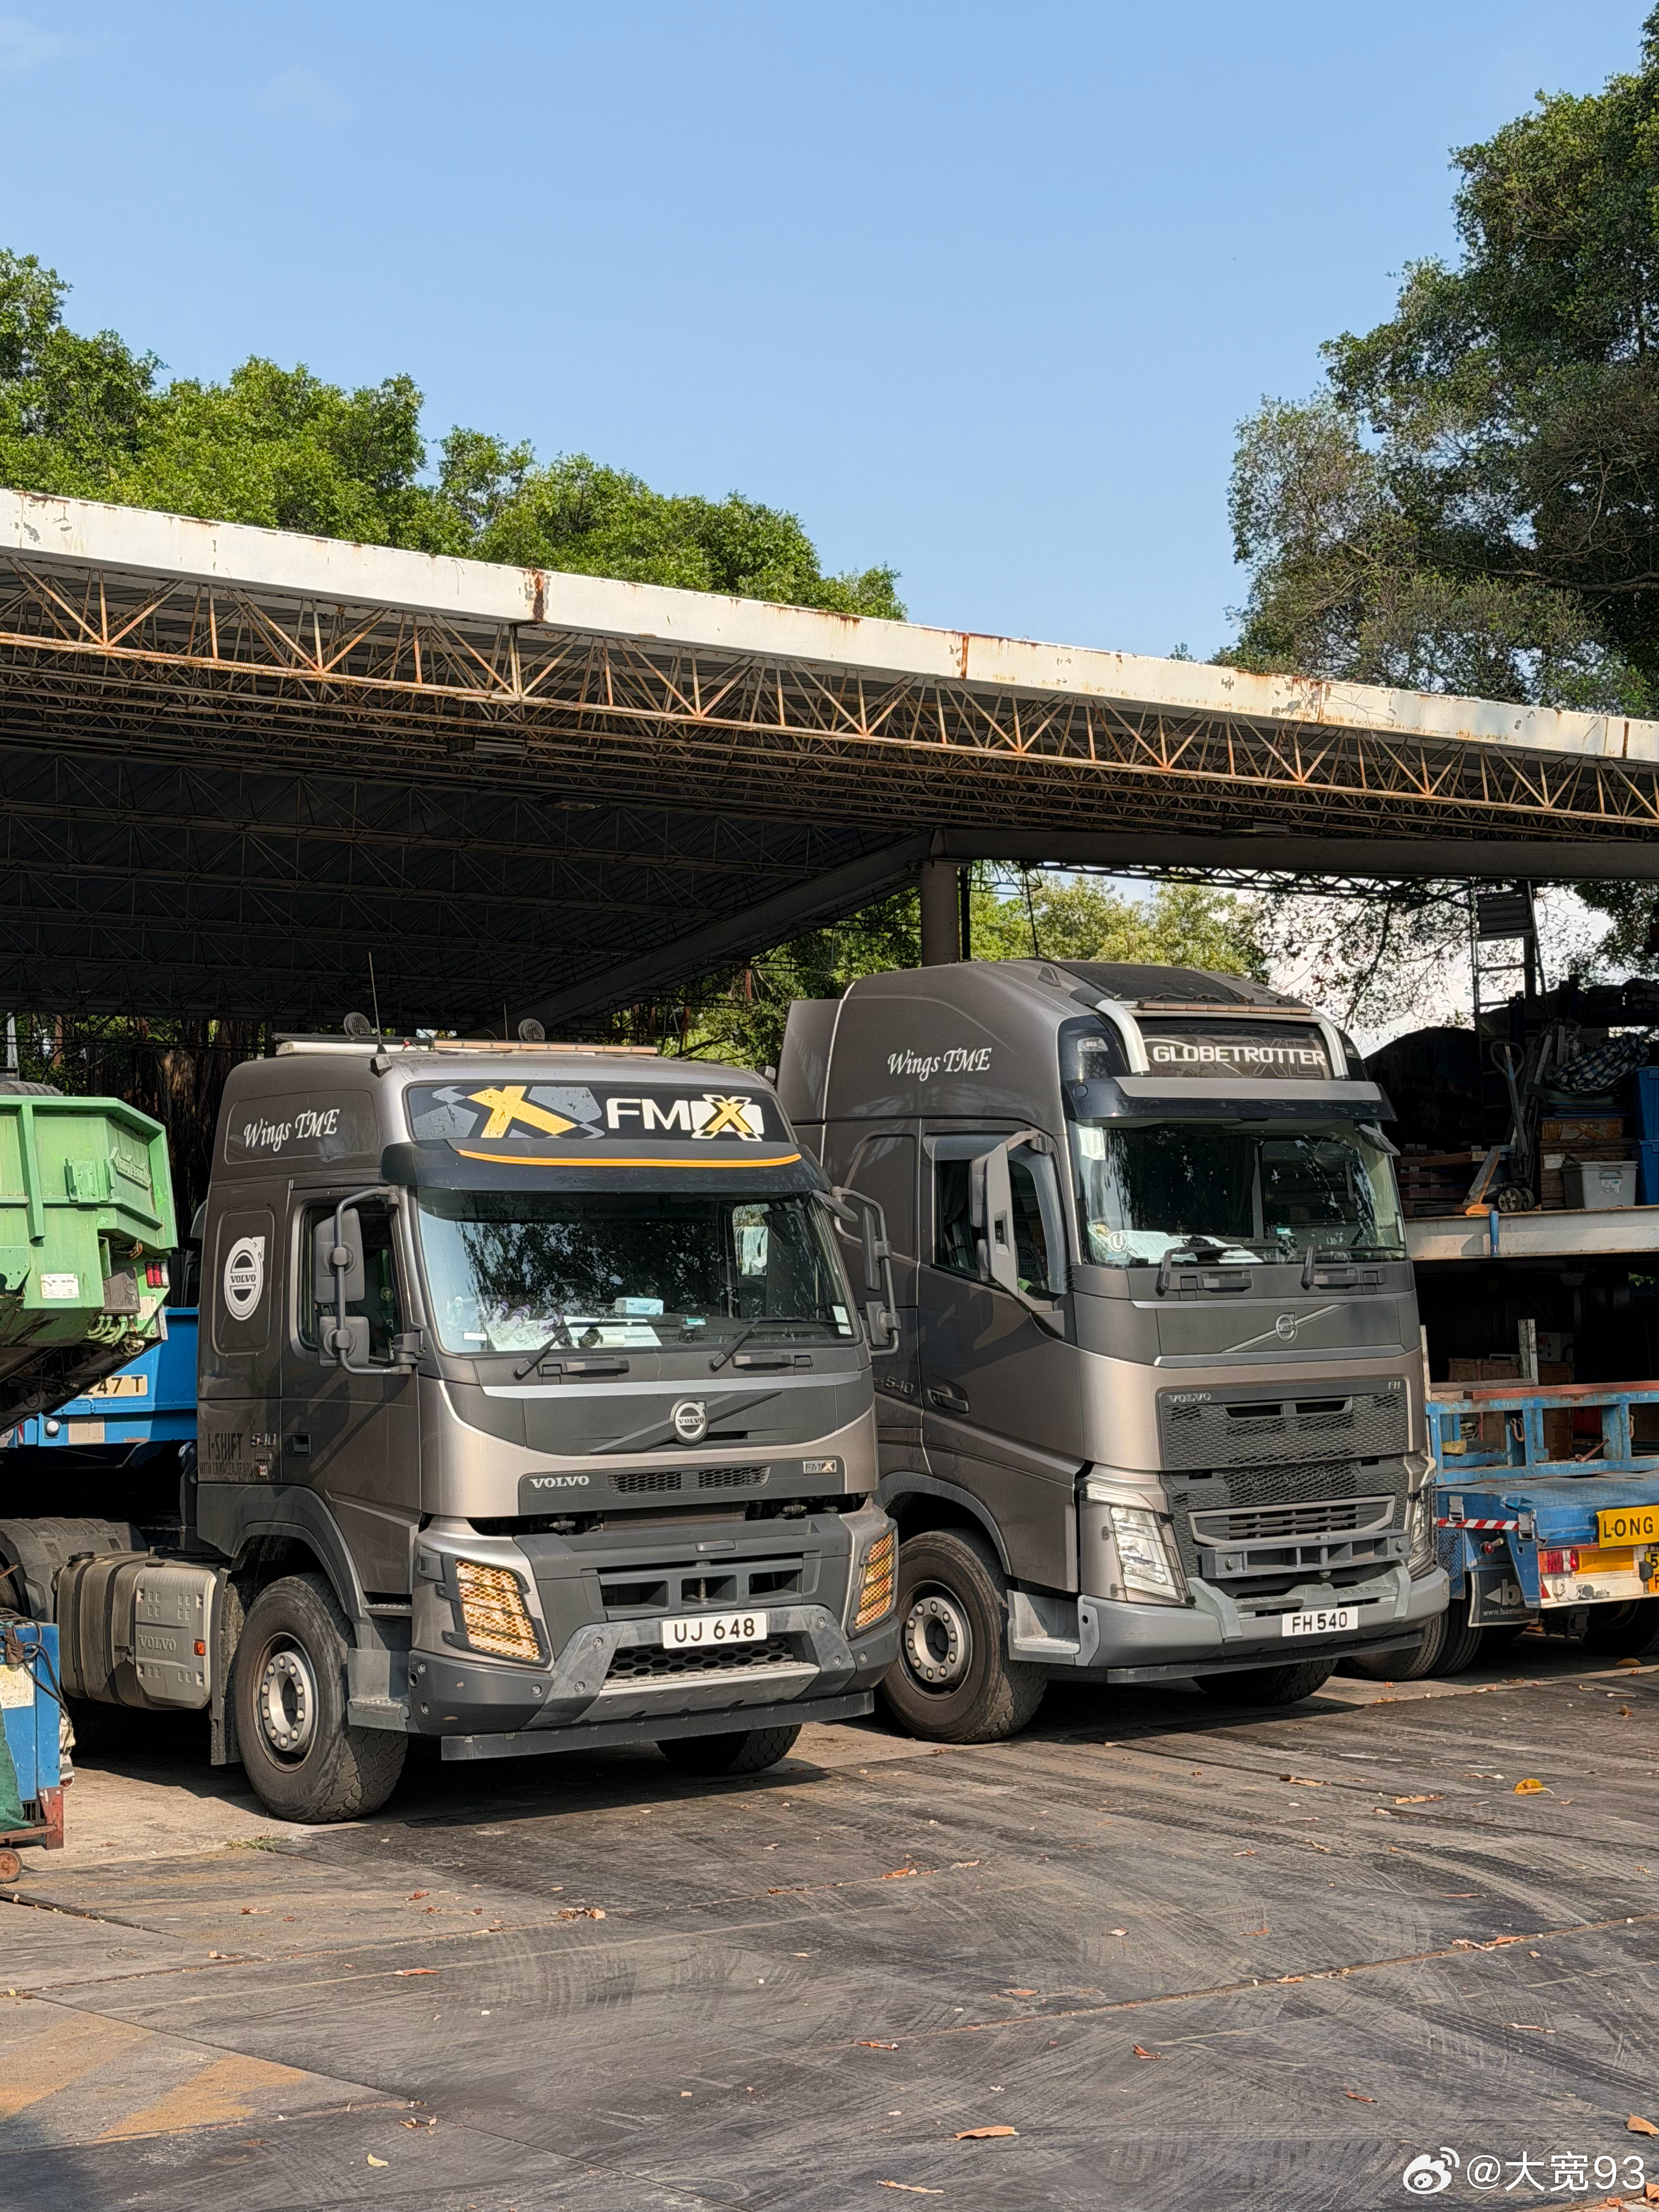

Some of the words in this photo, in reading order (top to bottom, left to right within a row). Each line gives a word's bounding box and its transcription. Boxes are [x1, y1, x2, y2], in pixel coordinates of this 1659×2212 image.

[887, 1043, 941, 1082] Wings
[1153, 1045, 1327, 1066] GLOBETROTTER
[606, 1094, 765, 1142] FMX
[244, 1118, 291, 1152] Wings
[230, 1273, 257, 1284] VOLVO
[82, 1376, 123, 1396] 47
[131, 1376, 144, 1393] T
[884, 1376, 914, 1393] 540
[1166, 1392, 1211, 1404] VOLVO
[208, 1432, 243, 1460] I-SHIFT
[251, 1432, 277, 1447] 540
[806, 1461, 836, 1472] FMX
[529, 1475, 590, 1489] VOLVO
[1604, 1516, 1654, 1539] LONG
[674, 1621, 703, 1643] UJ
[713, 1617, 755, 1640] 648
[1292, 1615, 1313, 1634] FH
[1317, 1611, 1347, 1630] 540
[137, 1635, 176, 1652] VOLVO
